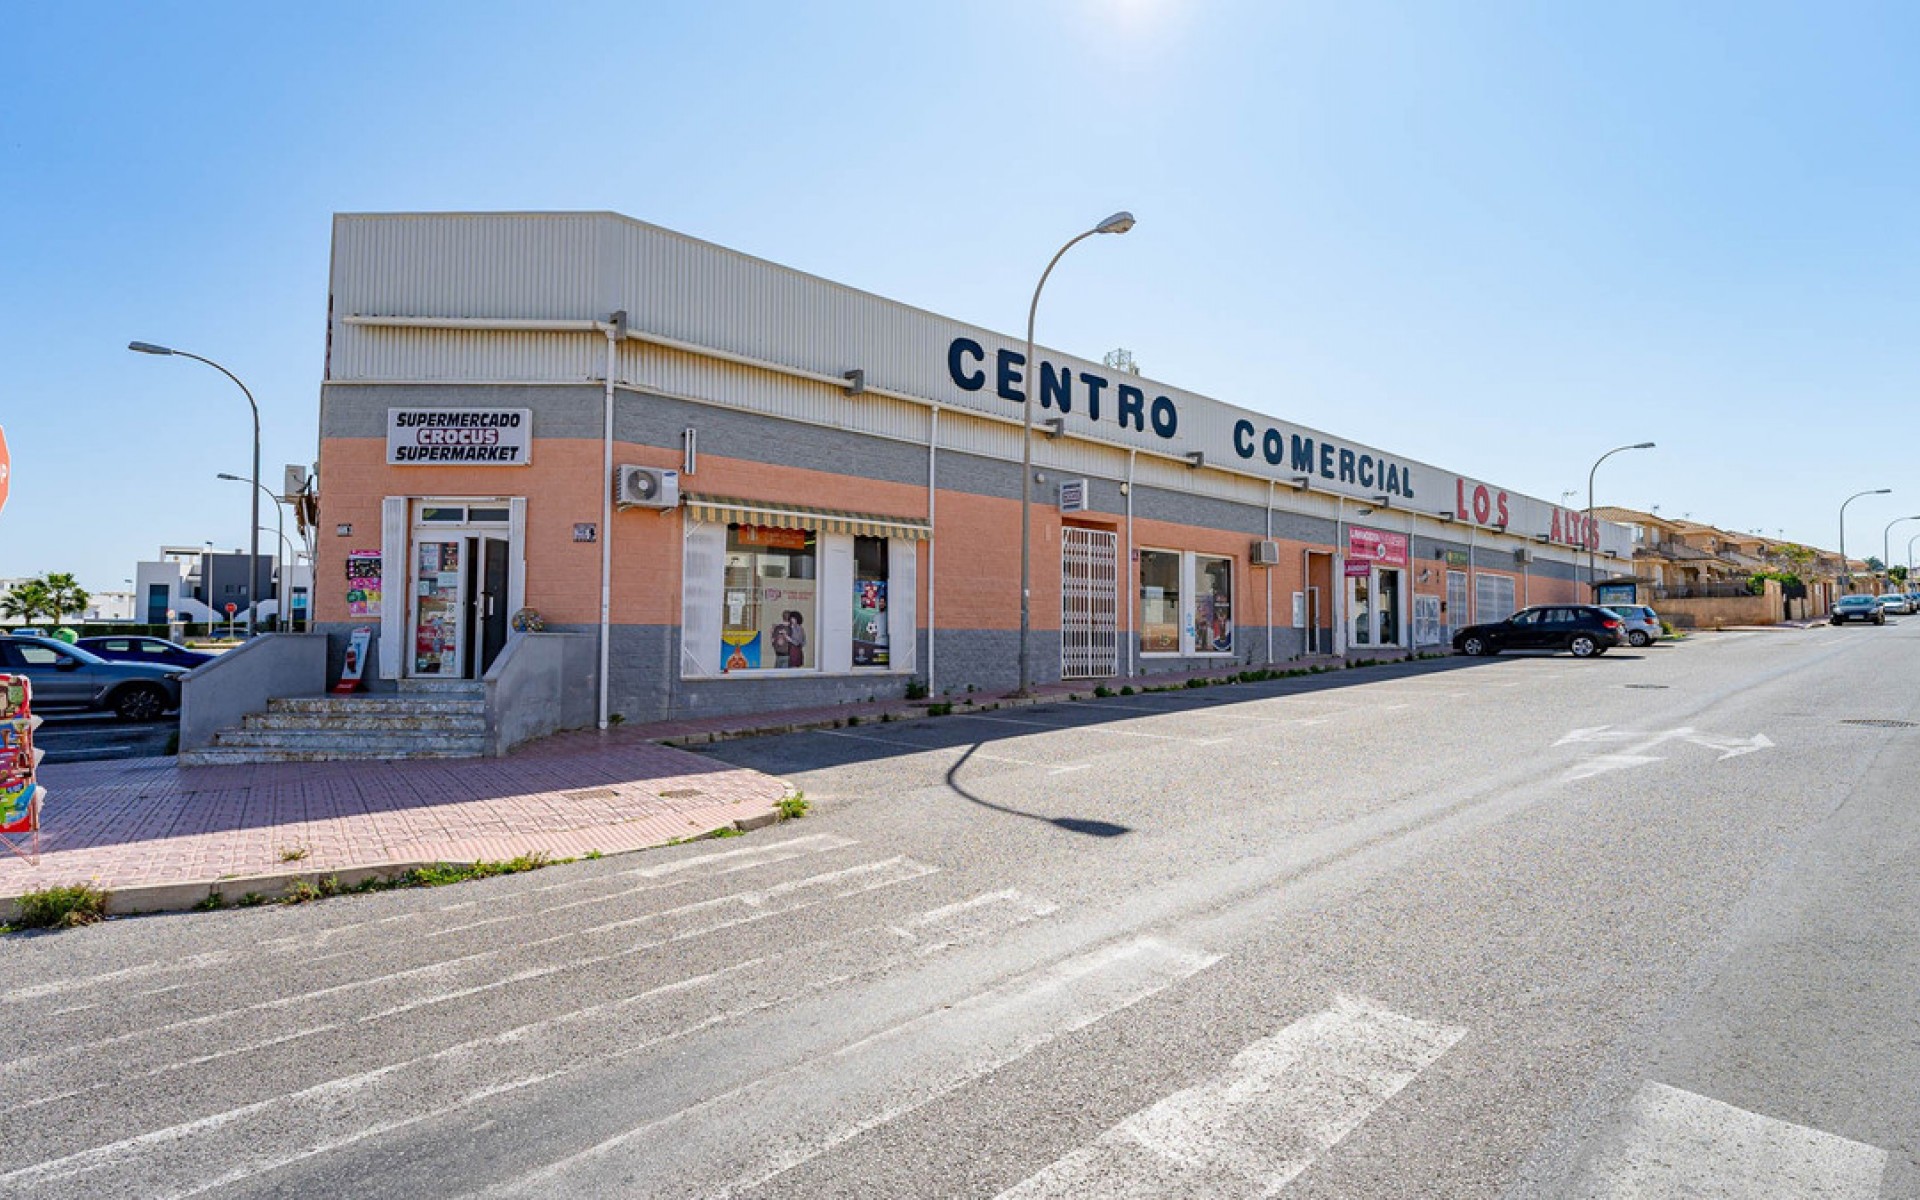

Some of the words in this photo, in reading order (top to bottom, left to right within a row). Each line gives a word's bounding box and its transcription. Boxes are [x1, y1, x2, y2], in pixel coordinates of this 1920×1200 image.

[396, 412, 520, 427] SUPERMERCADO
[418, 429, 498, 444] CROCUS
[948, 337, 1177, 439] CENTRO
[1234, 419, 1414, 498] COMERCIAL
[1456, 477, 1508, 526] LOS
[1551, 507, 1599, 550] ALTOS
[395, 446, 519, 460] SUPERMARKET
